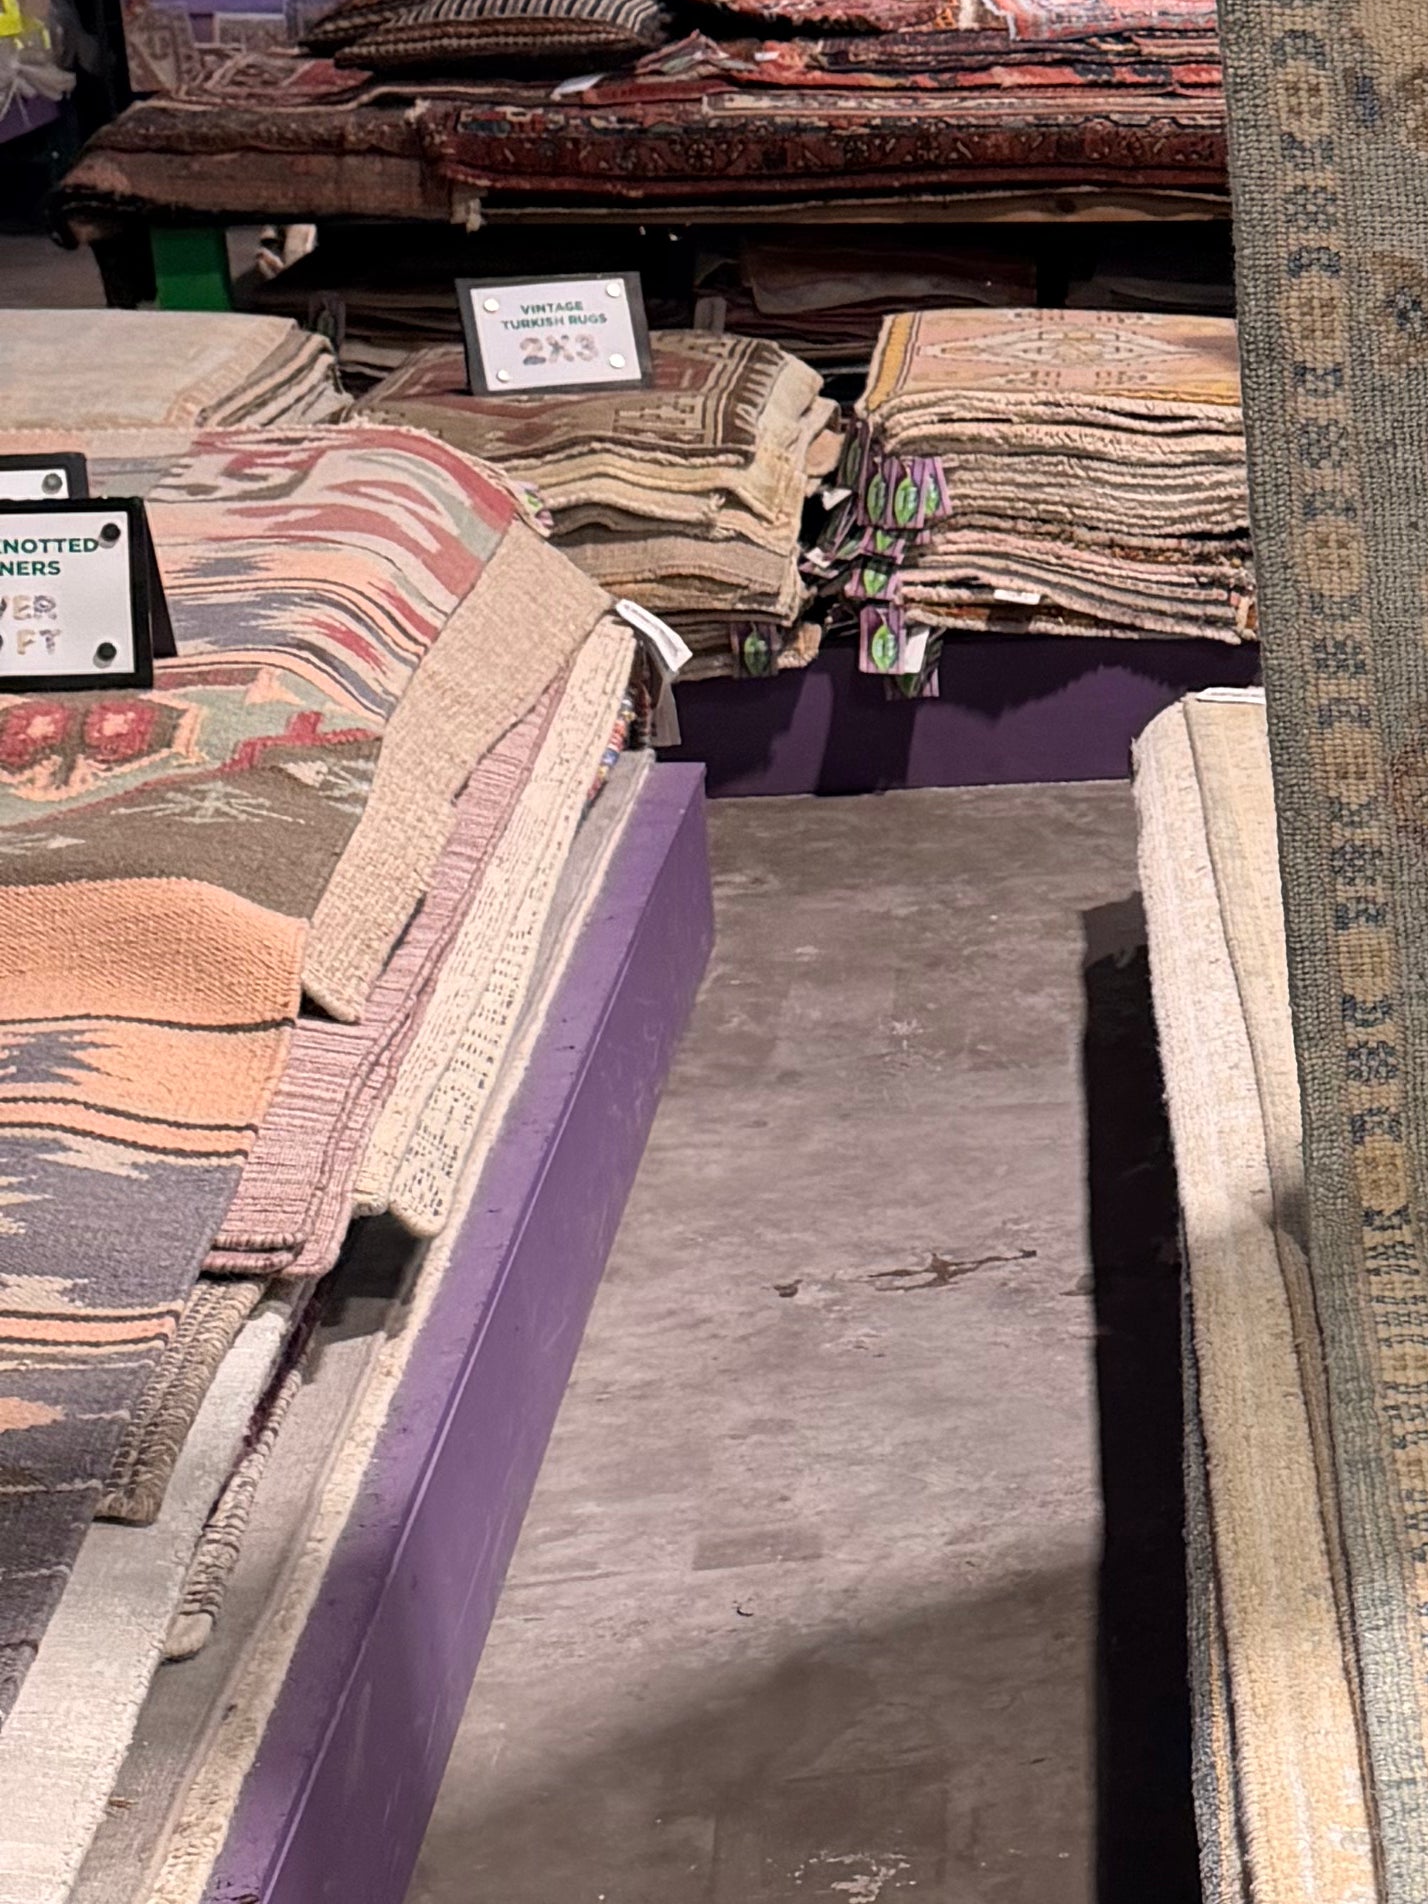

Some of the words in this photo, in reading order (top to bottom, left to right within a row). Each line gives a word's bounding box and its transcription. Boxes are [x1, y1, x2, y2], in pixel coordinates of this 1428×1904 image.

[520, 301, 584, 315] VINTAGE
[501, 316, 565, 331] TURKISH
[568, 313, 608, 326] RUGS
[519, 333, 600, 366] 2X3
[0, 538, 99, 554] NOTTED
